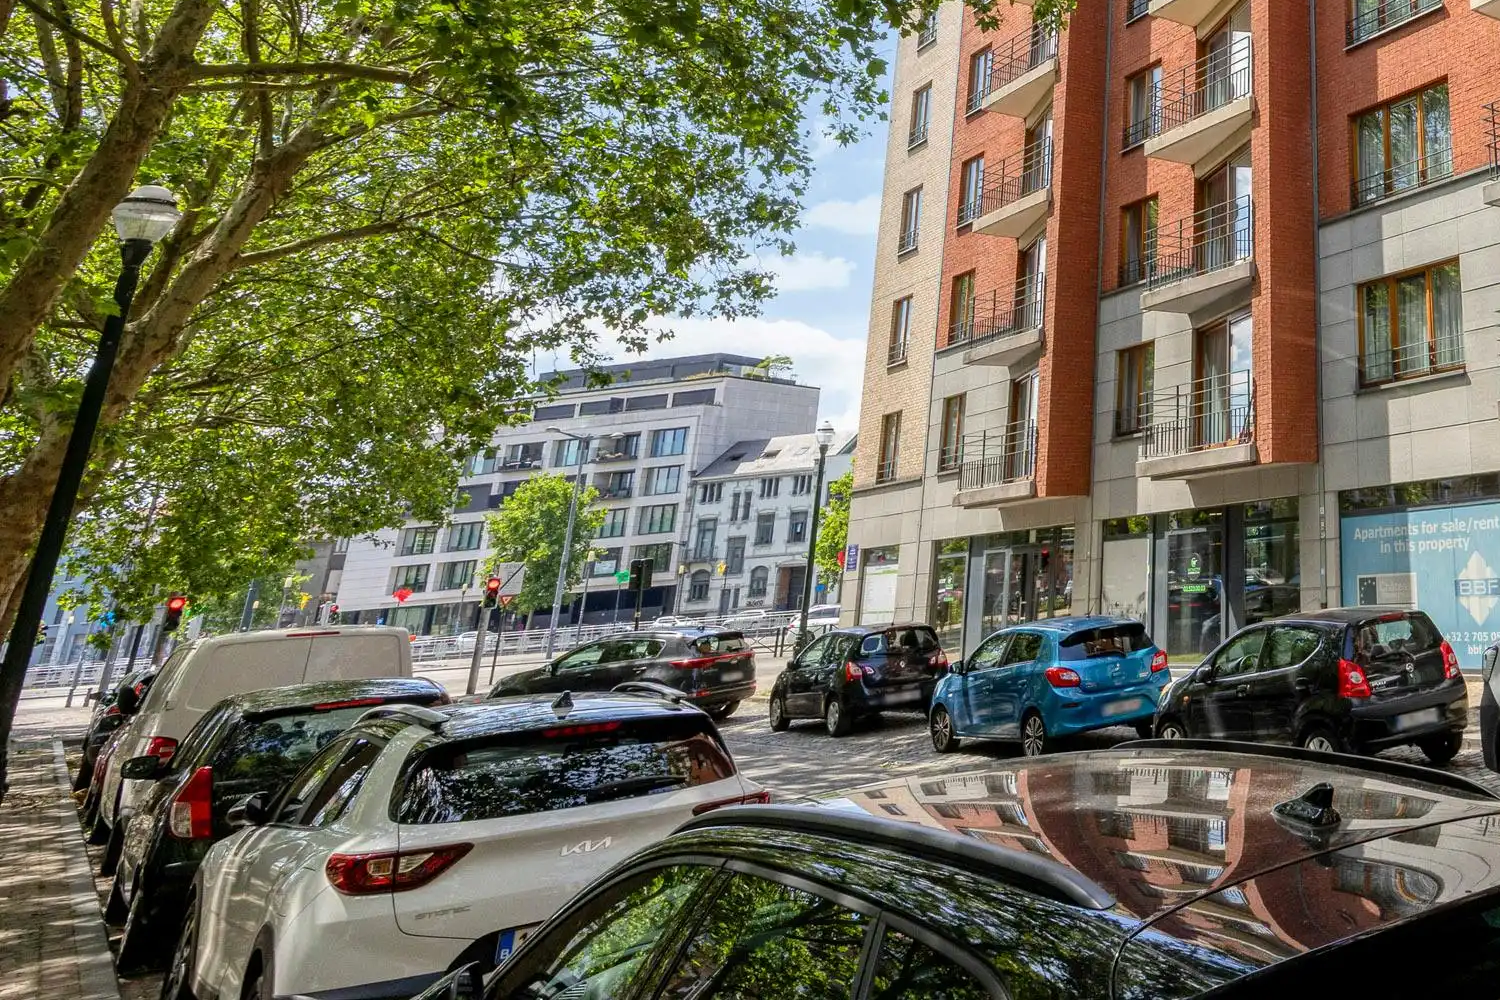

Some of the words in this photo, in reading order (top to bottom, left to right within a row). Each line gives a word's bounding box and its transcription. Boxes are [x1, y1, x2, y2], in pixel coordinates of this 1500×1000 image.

[1354, 523, 1418, 542] Apartments
[1421, 521, 1438, 534] for
[1441, 516, 1500, 533] sale/rent
[1380, 541, 1391, 553] in
[1393, 538, 1415, 552] this
[1418, 537, 1470, 554] property
[1459, 580, 1498, 595] BBF
[1445, 632, 1462, 642] +32
[1464, 632, 1470, 641] 2
[1472, 632, 1489, 642] 705
